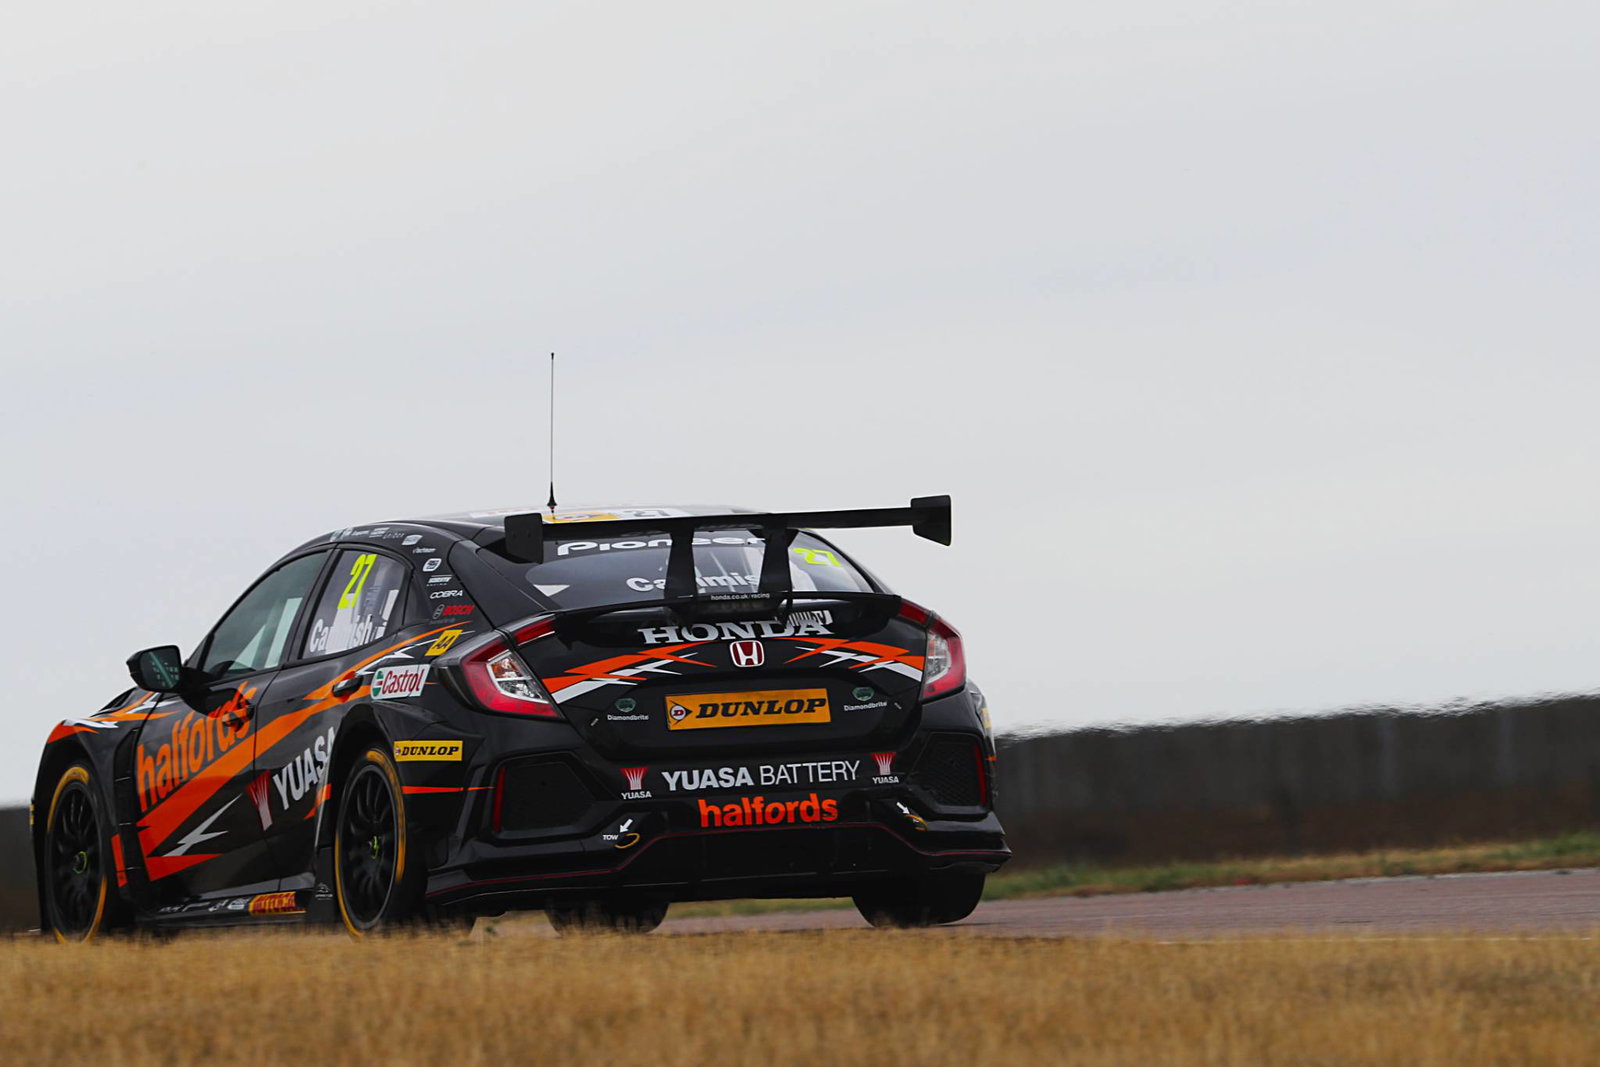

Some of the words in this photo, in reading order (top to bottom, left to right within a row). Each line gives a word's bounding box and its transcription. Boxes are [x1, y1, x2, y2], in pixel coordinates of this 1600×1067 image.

[794, 547, 840, 567] 27
[337, 554, 378, 609] 27
[429, 590, 463, 599] COBRA
[637, 619, 835, 644] HONDA
[382, 668, 425, 695] Castrol
[696, 698, 826, 718] DUNLOP
[844, 701, 888, 712] Diamondbrite
[136, 680, 257, 812] halfords
[401, 746, 459, 756] DUNLOP
[661, 767, 754, 791] YUASA
[760, 760, 860, 786] BATTERY
[872, 775, 899, 784] YUASA
[621, 790, 652, 799] YUASA
[698, 793, 838, 828] halfords
